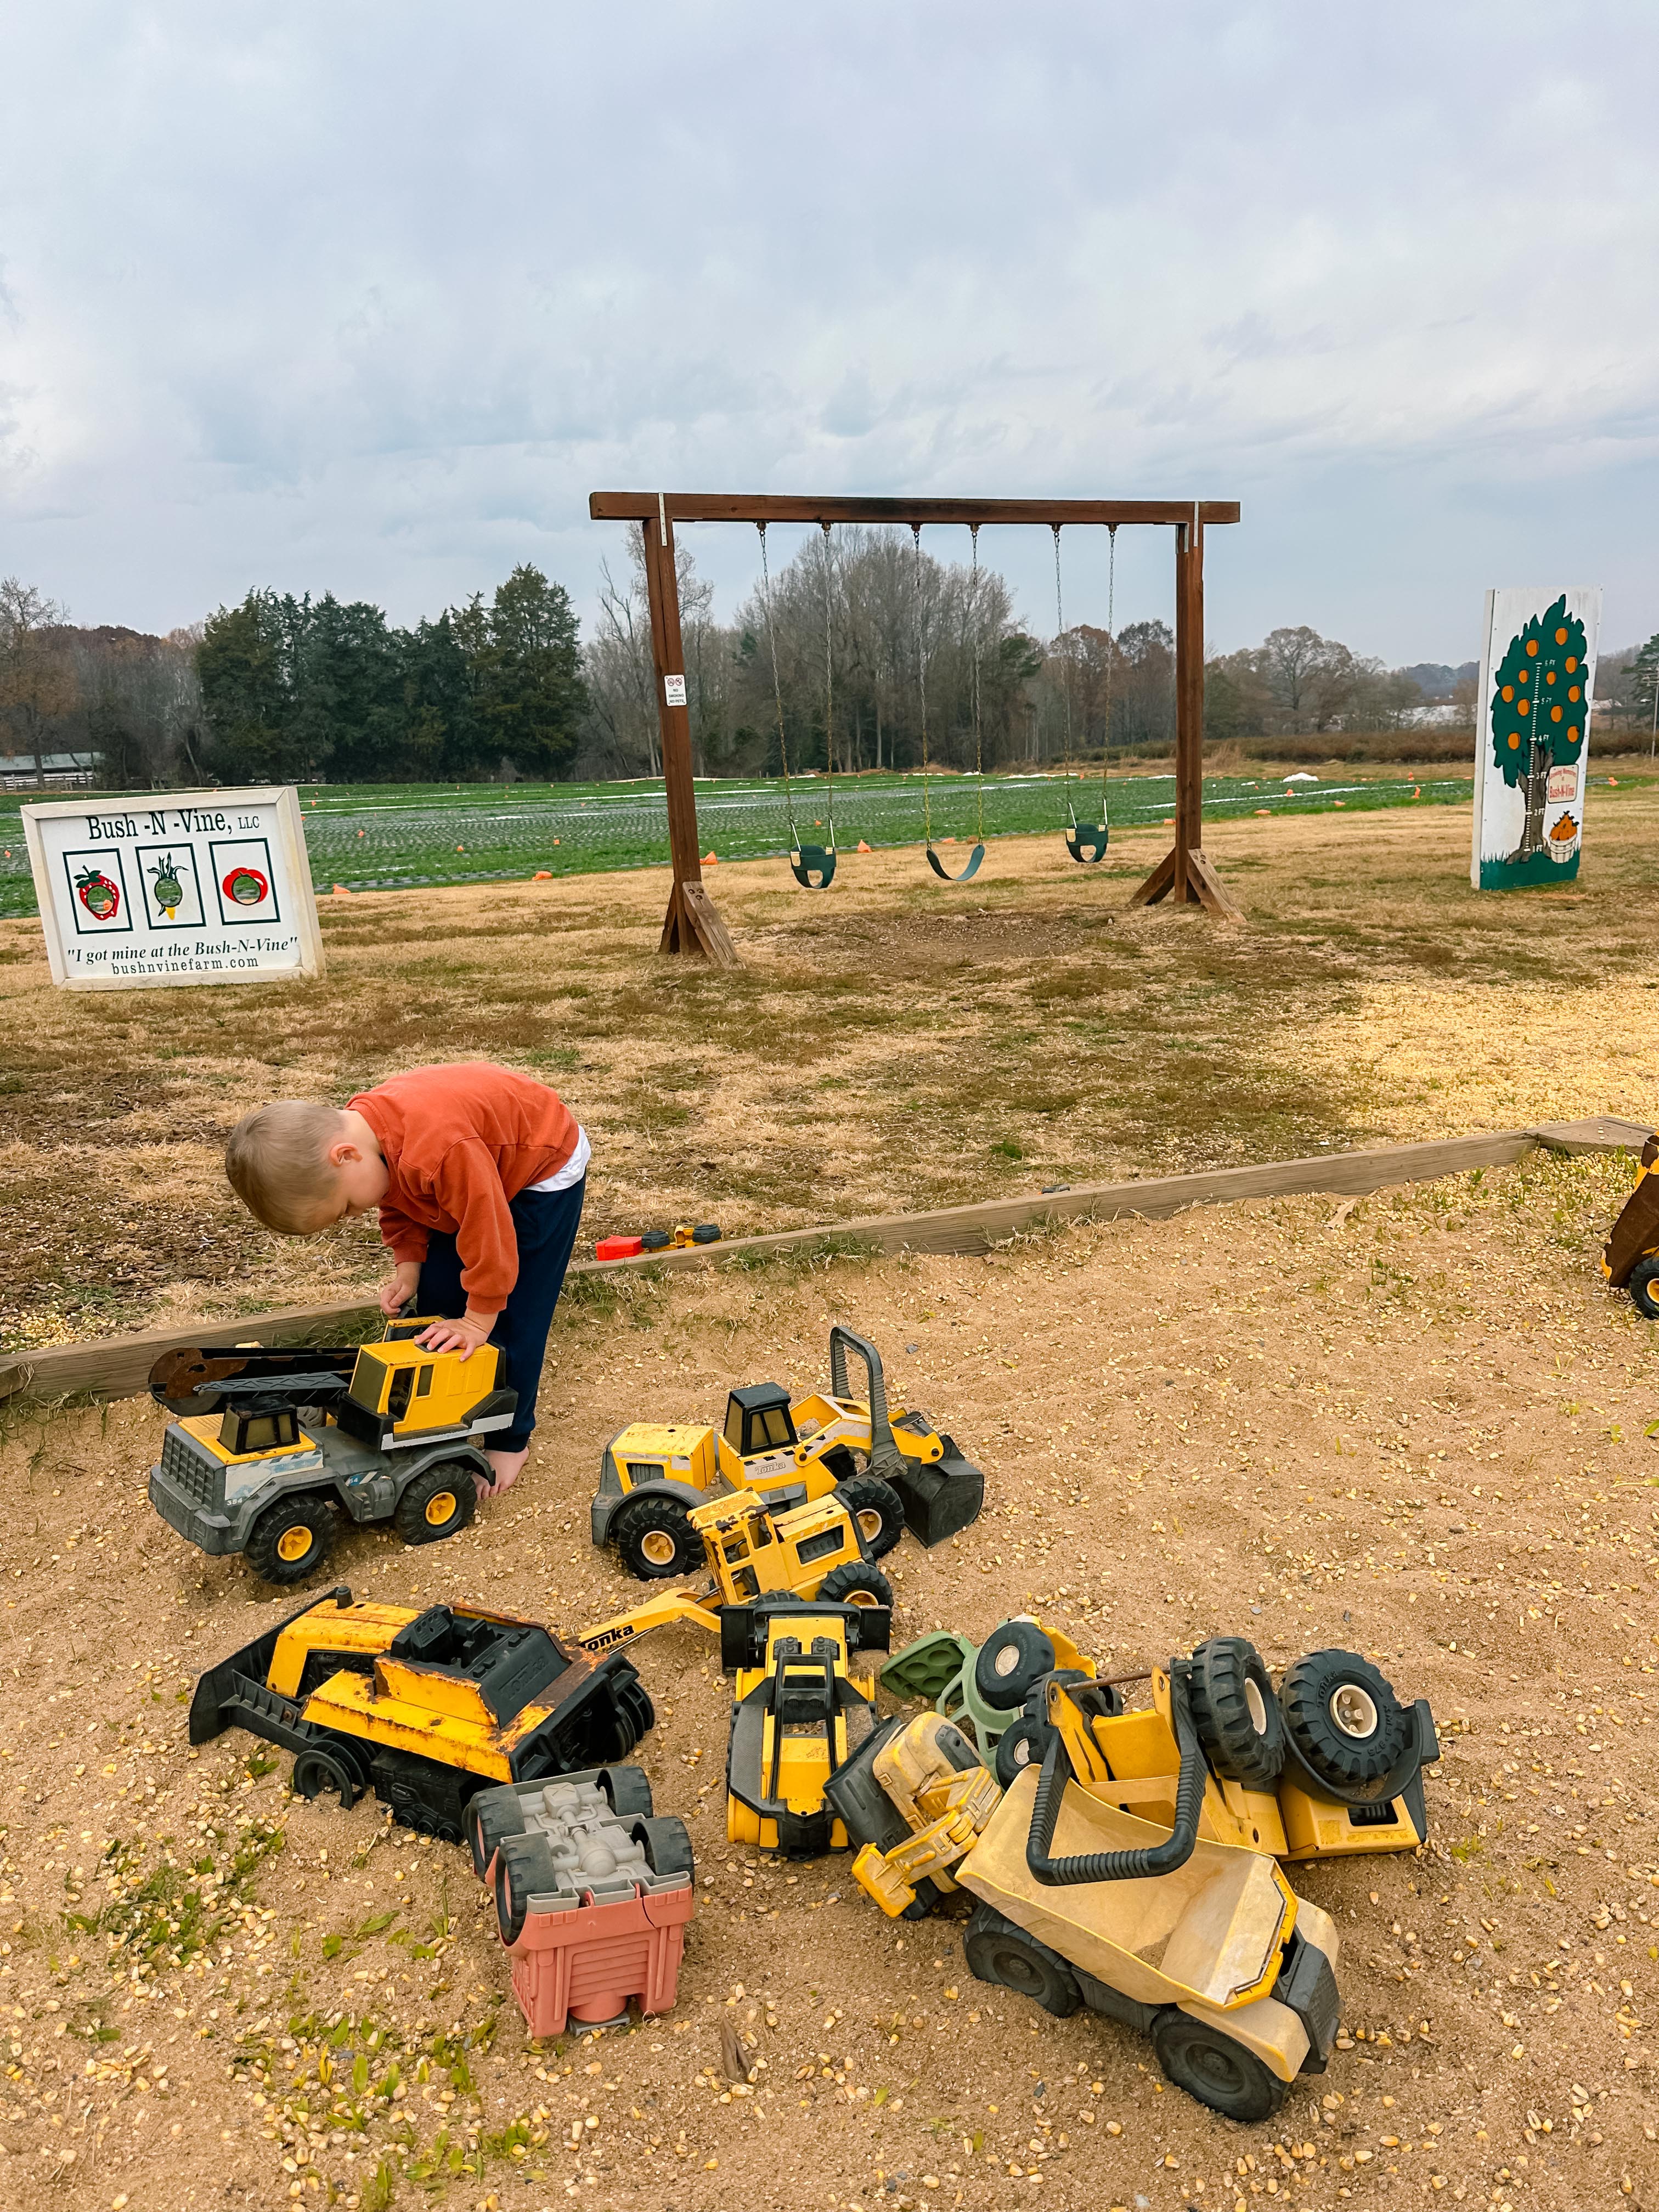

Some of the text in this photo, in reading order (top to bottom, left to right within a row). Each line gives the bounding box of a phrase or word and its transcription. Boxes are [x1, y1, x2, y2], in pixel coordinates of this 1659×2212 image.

[238, 816, 259, 829] LLC
[68, 936, 298, 965] "I got mine at the Bush-N-Vine"
[111, 957, 259, 974] bushnvinefarm.com
[754, 1462, 786, 1475] Tonka
